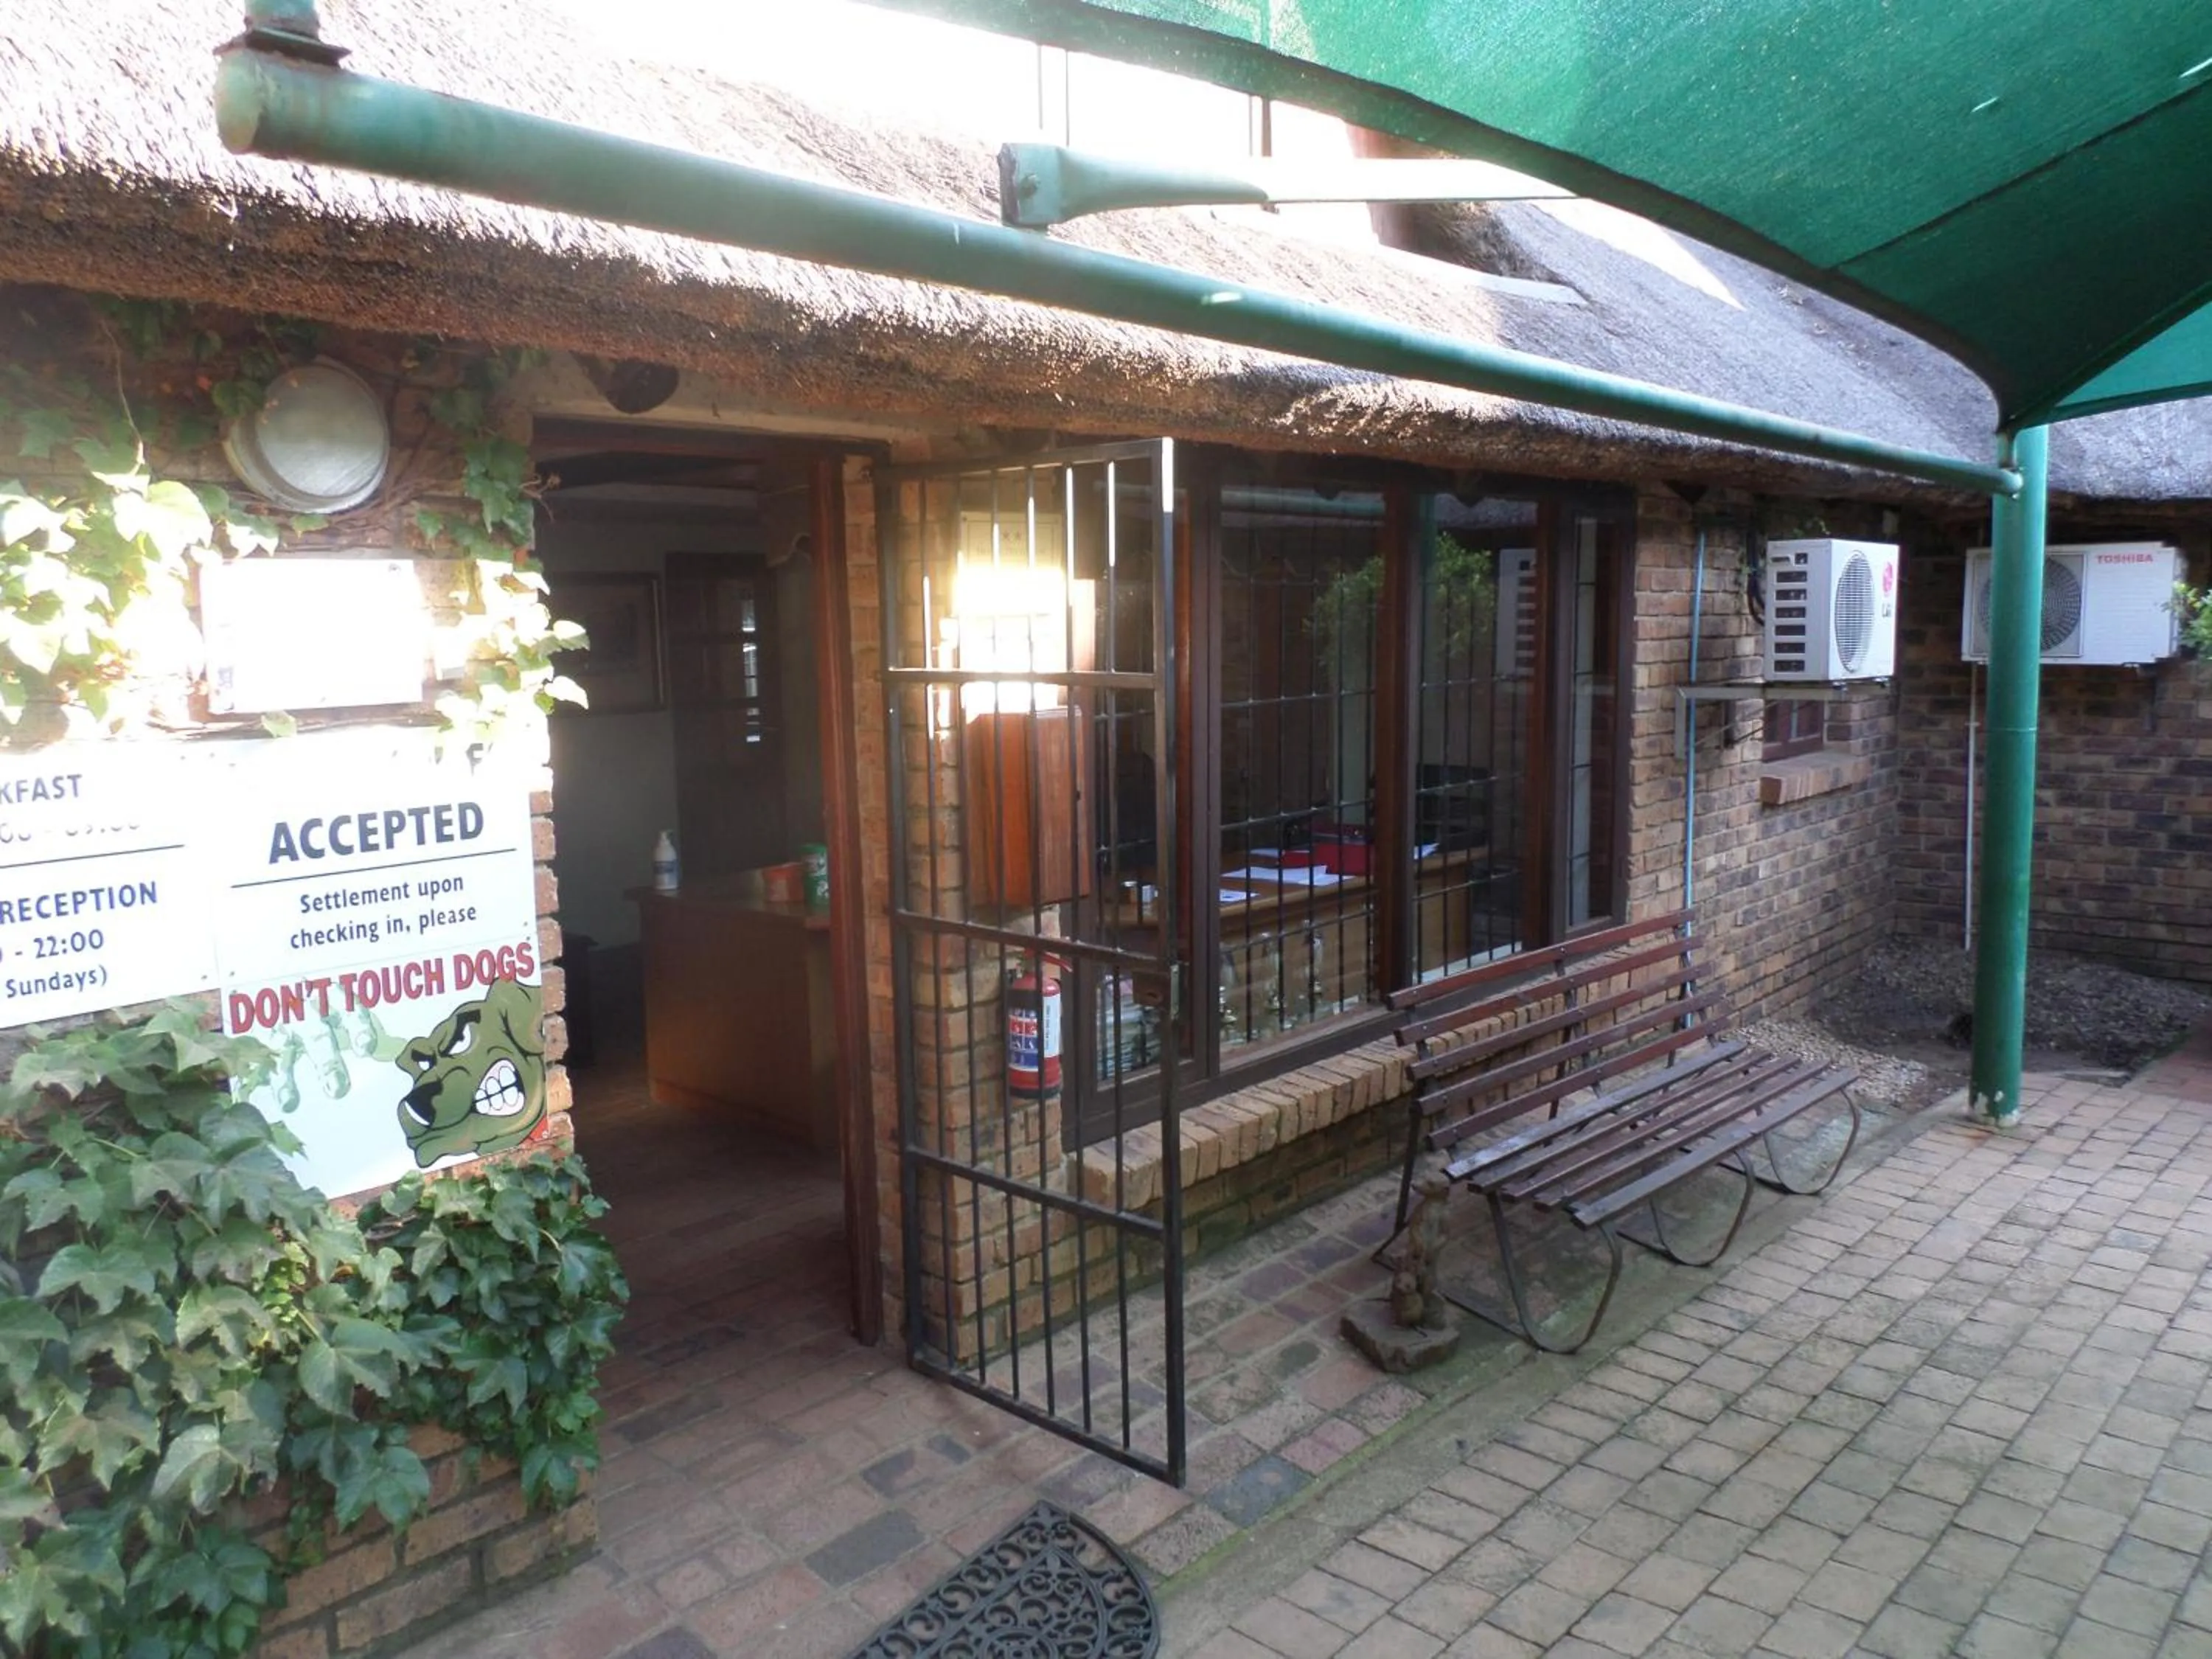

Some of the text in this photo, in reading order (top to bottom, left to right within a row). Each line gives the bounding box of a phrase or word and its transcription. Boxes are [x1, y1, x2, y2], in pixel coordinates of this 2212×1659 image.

[2096, 553, 2154, 565] TOSHIBA
[268, 801, 485, 865] ACCEPTED
[0, 880, 158, 924] RECEPTION
[300, 876, 465, 914] Settlement upon
[33, 928, 104, 959] 22:00
[290, 905, 478, 949] checking in, please
[6, 964, 108, 999] Sundays)
[229, 941, 536, 1034] DON'T TOUCH DOGS
